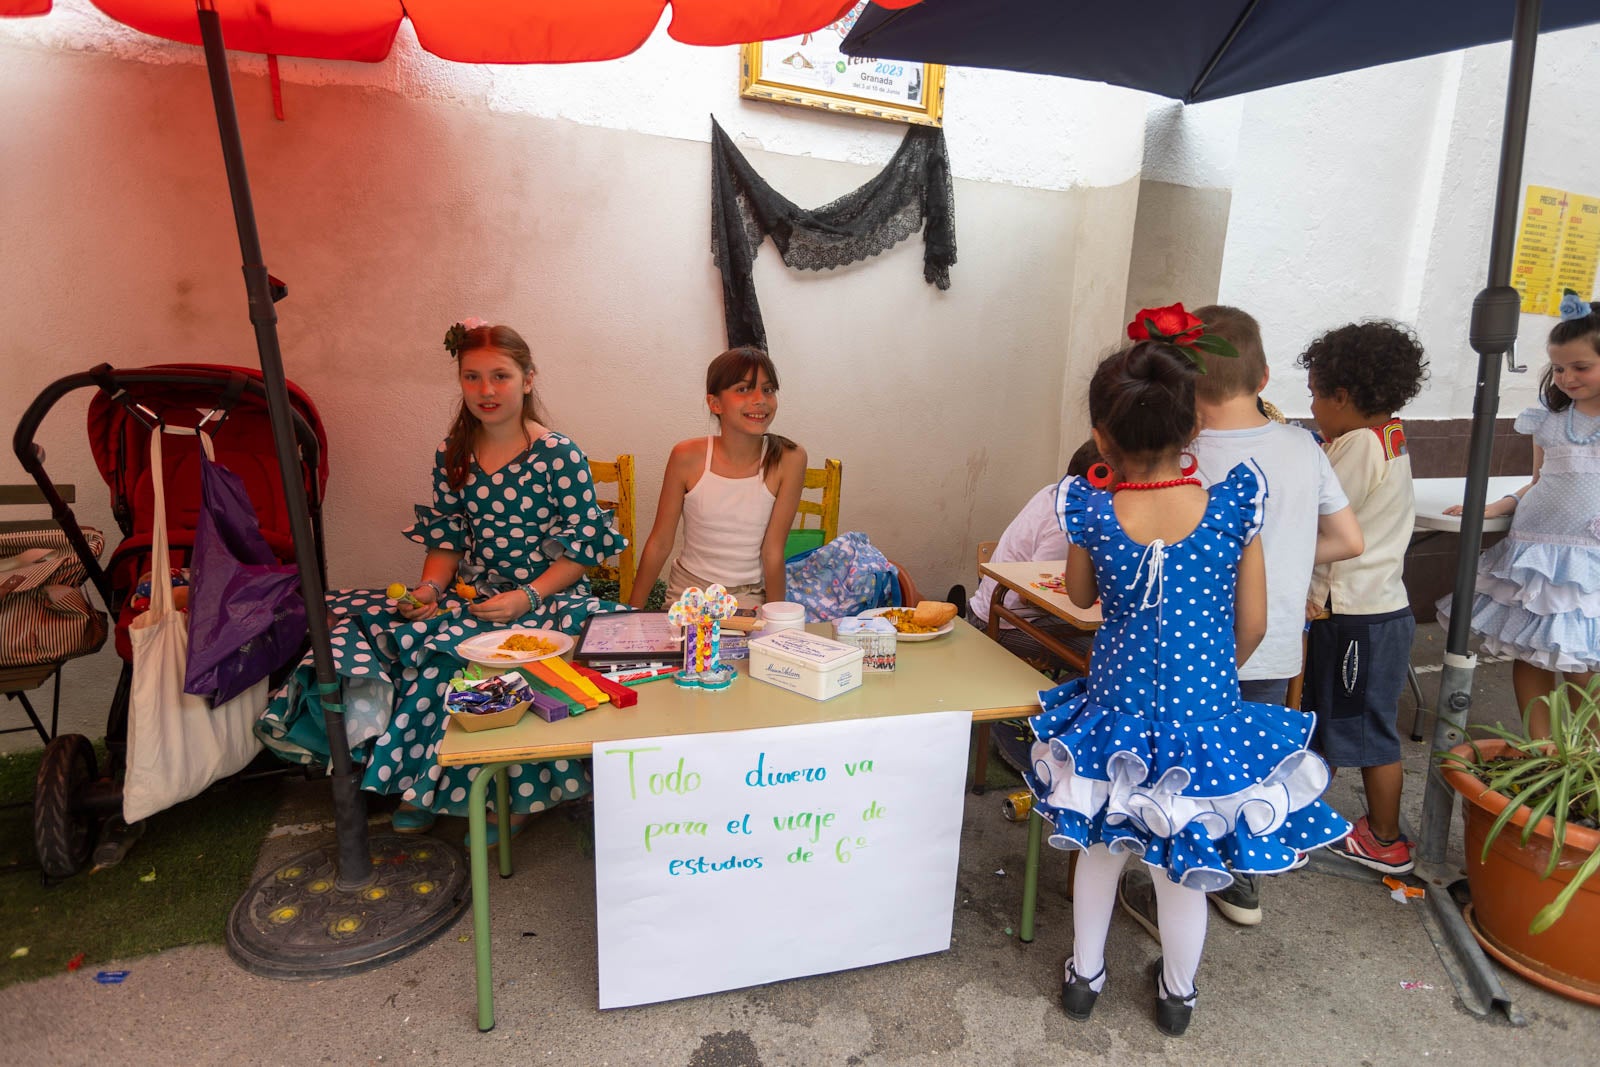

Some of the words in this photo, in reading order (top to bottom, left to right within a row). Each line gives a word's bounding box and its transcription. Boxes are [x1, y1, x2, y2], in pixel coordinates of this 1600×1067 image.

[860, 72, 893, 86] Granada
[875, 62, 904, 77] 2023
[605, 747, 701, 800] Todo
[745, 752, 827, 787] dinero
[845, 759, 874, 777] va
[644, 821, 708, 852] para
[726, 814, 752, 835] el
[773, 809, 836, 843] viaje
[862, 801, 887, 822] de
[669, 856, 764, 876] estudios
[787, 847, 814, 863] de
